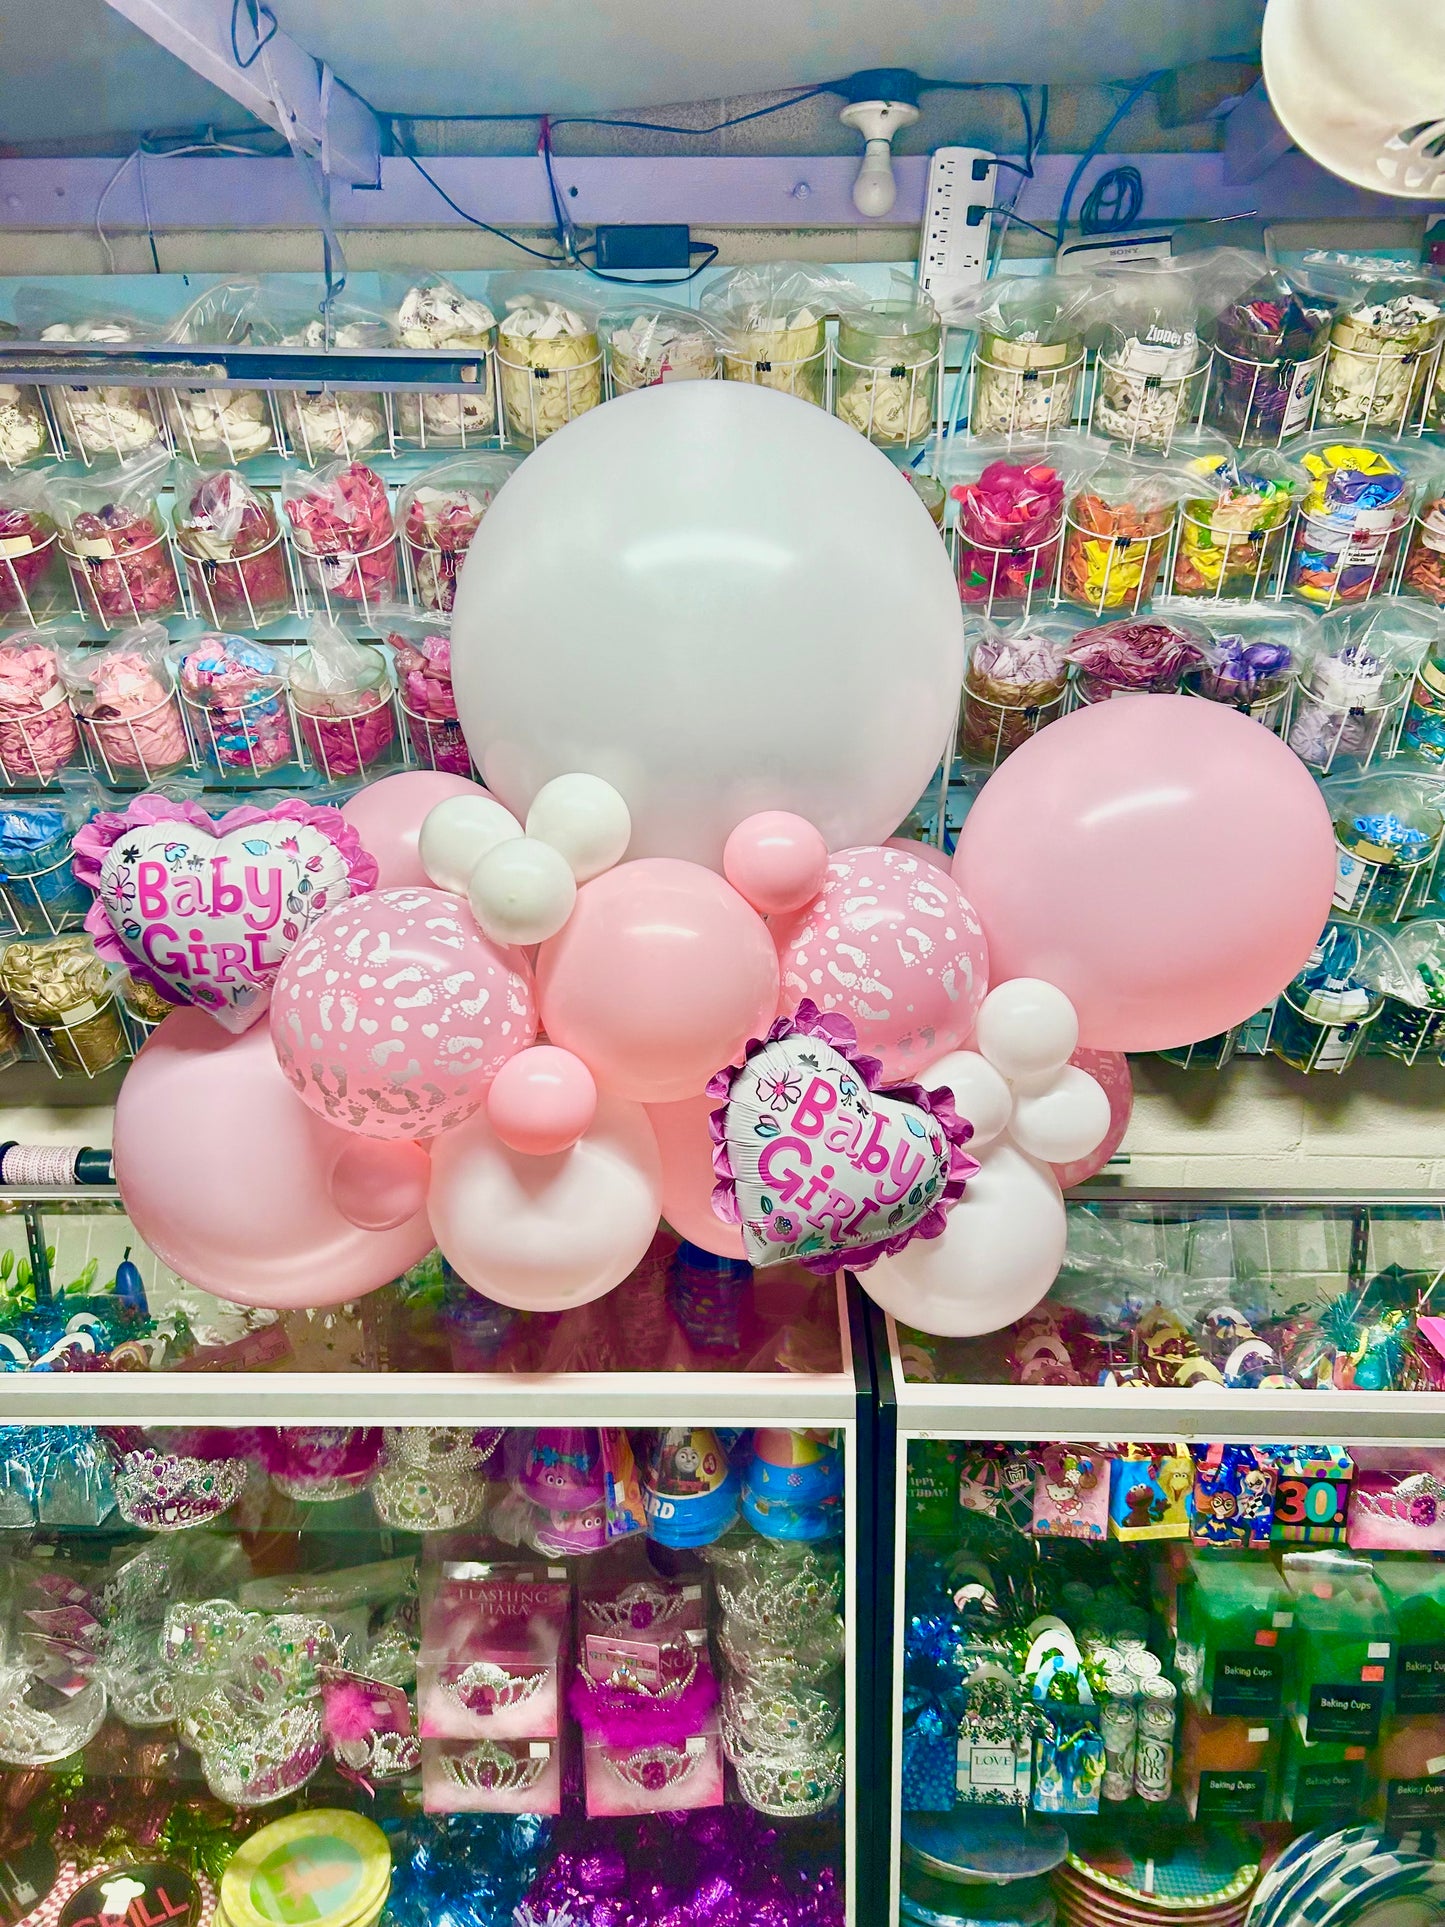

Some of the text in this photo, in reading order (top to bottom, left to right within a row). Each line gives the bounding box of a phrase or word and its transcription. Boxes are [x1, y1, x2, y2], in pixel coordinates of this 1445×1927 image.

[1109, 247, 1140, 257] SONY
[1145, 323, 1182, 346] Zipper
[137, 855, 283, 931] Baby
[790, 1076, 926, 1205] Baby
[909, 1477, 937, 1487] APPY
[1274, 1480, 1348, 1523] 30!
[459, 1588, 548, 1603] FLASHING
[478, 1602, 529, 1616] TIARA
[1224, 1665, 1273, 1677] Baking Cups
[1405, 1661, 1432, 1673] Baking
[1320, 1698, 1372, 1711] Baking Cups
[974, 1755, 1013, 1766] LOVE
[1209, 1780, 1256, 1791] Baking Cups
[1397, 1784, 1444, 1796] Baking Cups
